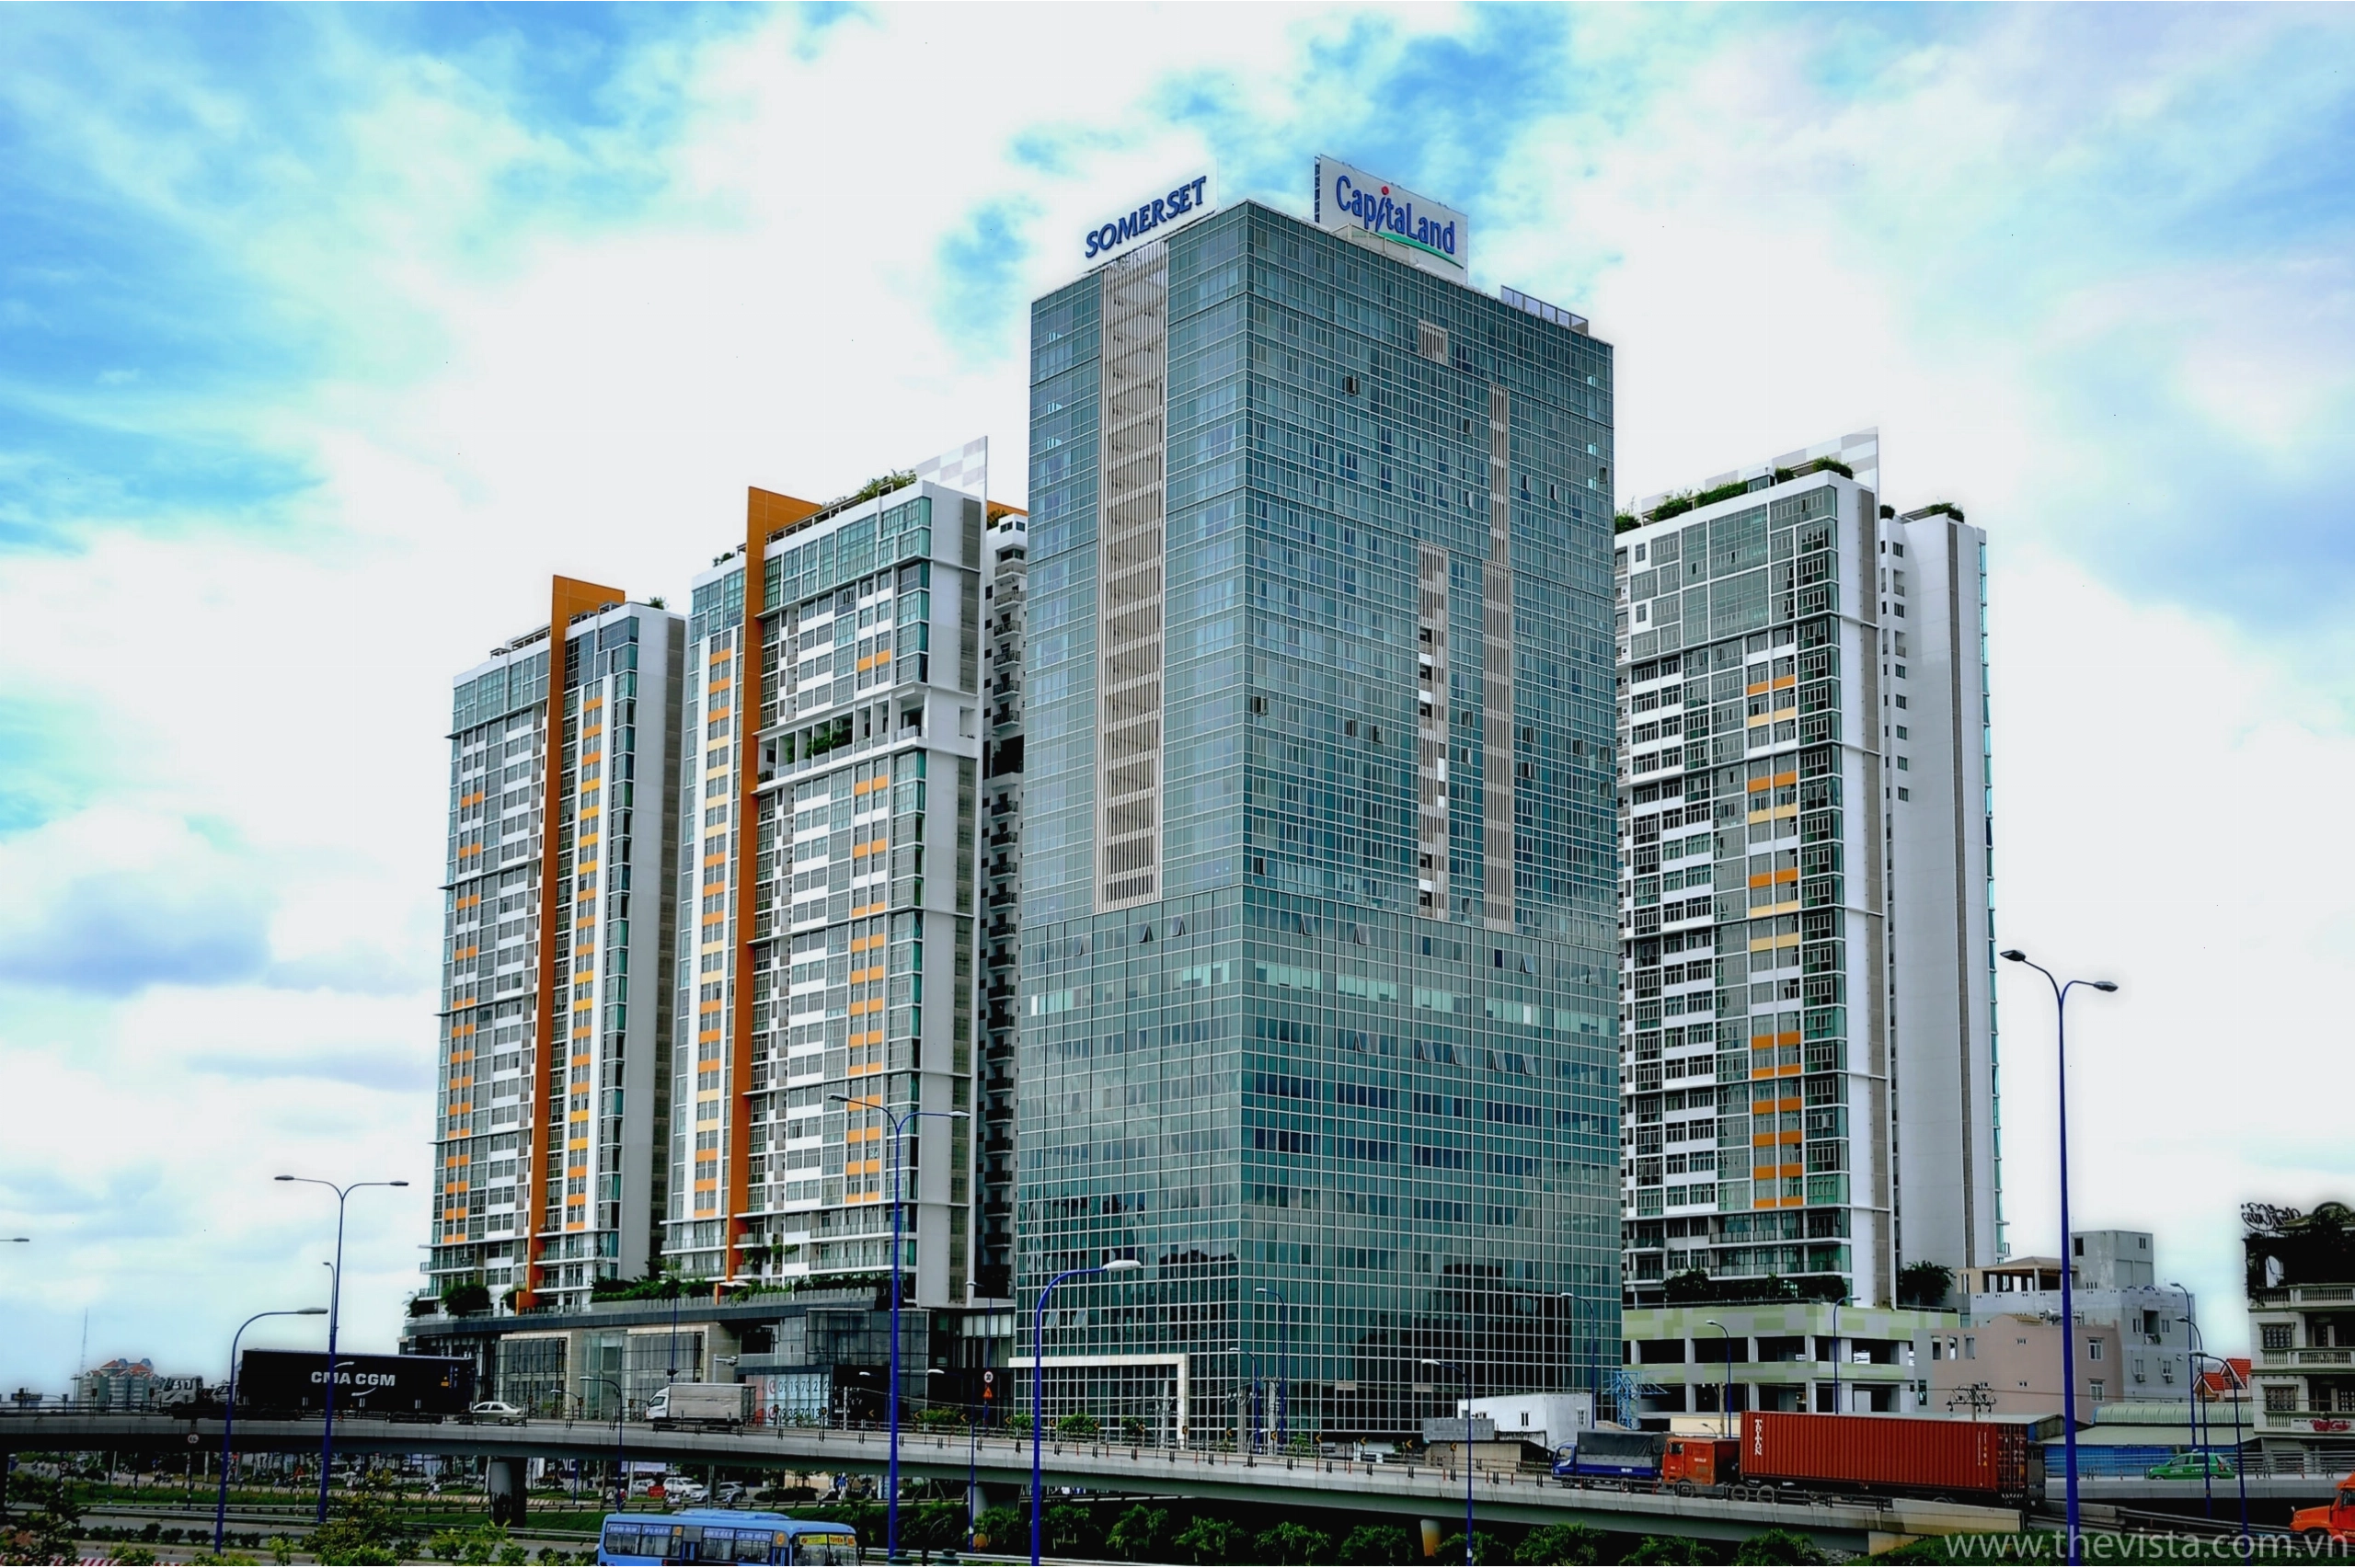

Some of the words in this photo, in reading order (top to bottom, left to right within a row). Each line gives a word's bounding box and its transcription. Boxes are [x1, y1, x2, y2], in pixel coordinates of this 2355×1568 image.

[1085, 176, 1207, 258] SOMERSET
[1336, 175, 1455, 255] CapitaLand
[311, 1371, 351, 1384] CMA
[355, 1373, 396, 1386] CGM
[1754, 1419, 1763, 1456] TRITON
